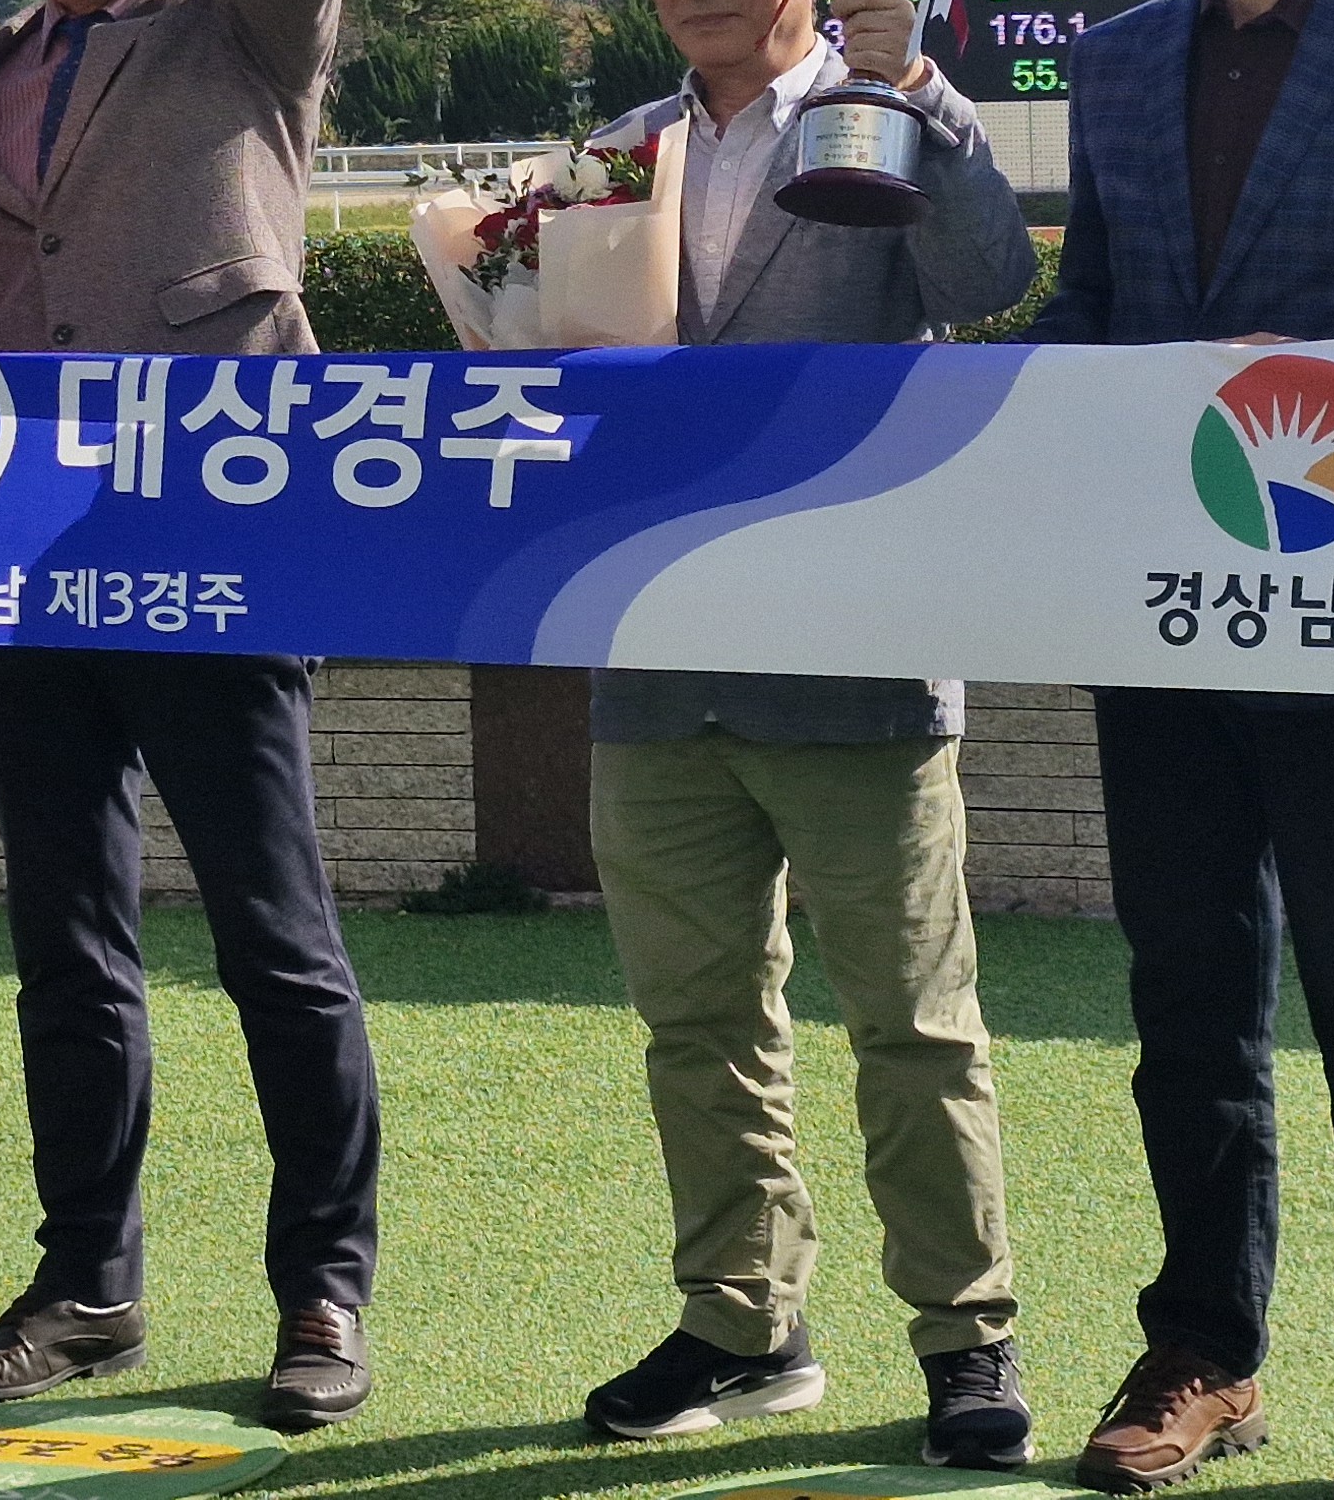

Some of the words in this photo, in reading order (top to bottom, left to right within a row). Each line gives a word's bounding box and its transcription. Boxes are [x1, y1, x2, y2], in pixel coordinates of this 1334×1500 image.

[990, 12, 1087, 45] 176.1
[1012, 59, 1068, 92] 55.
[56, 354, 574, 509] 대상경주
[46, 568, 249, 634] 제3경주
